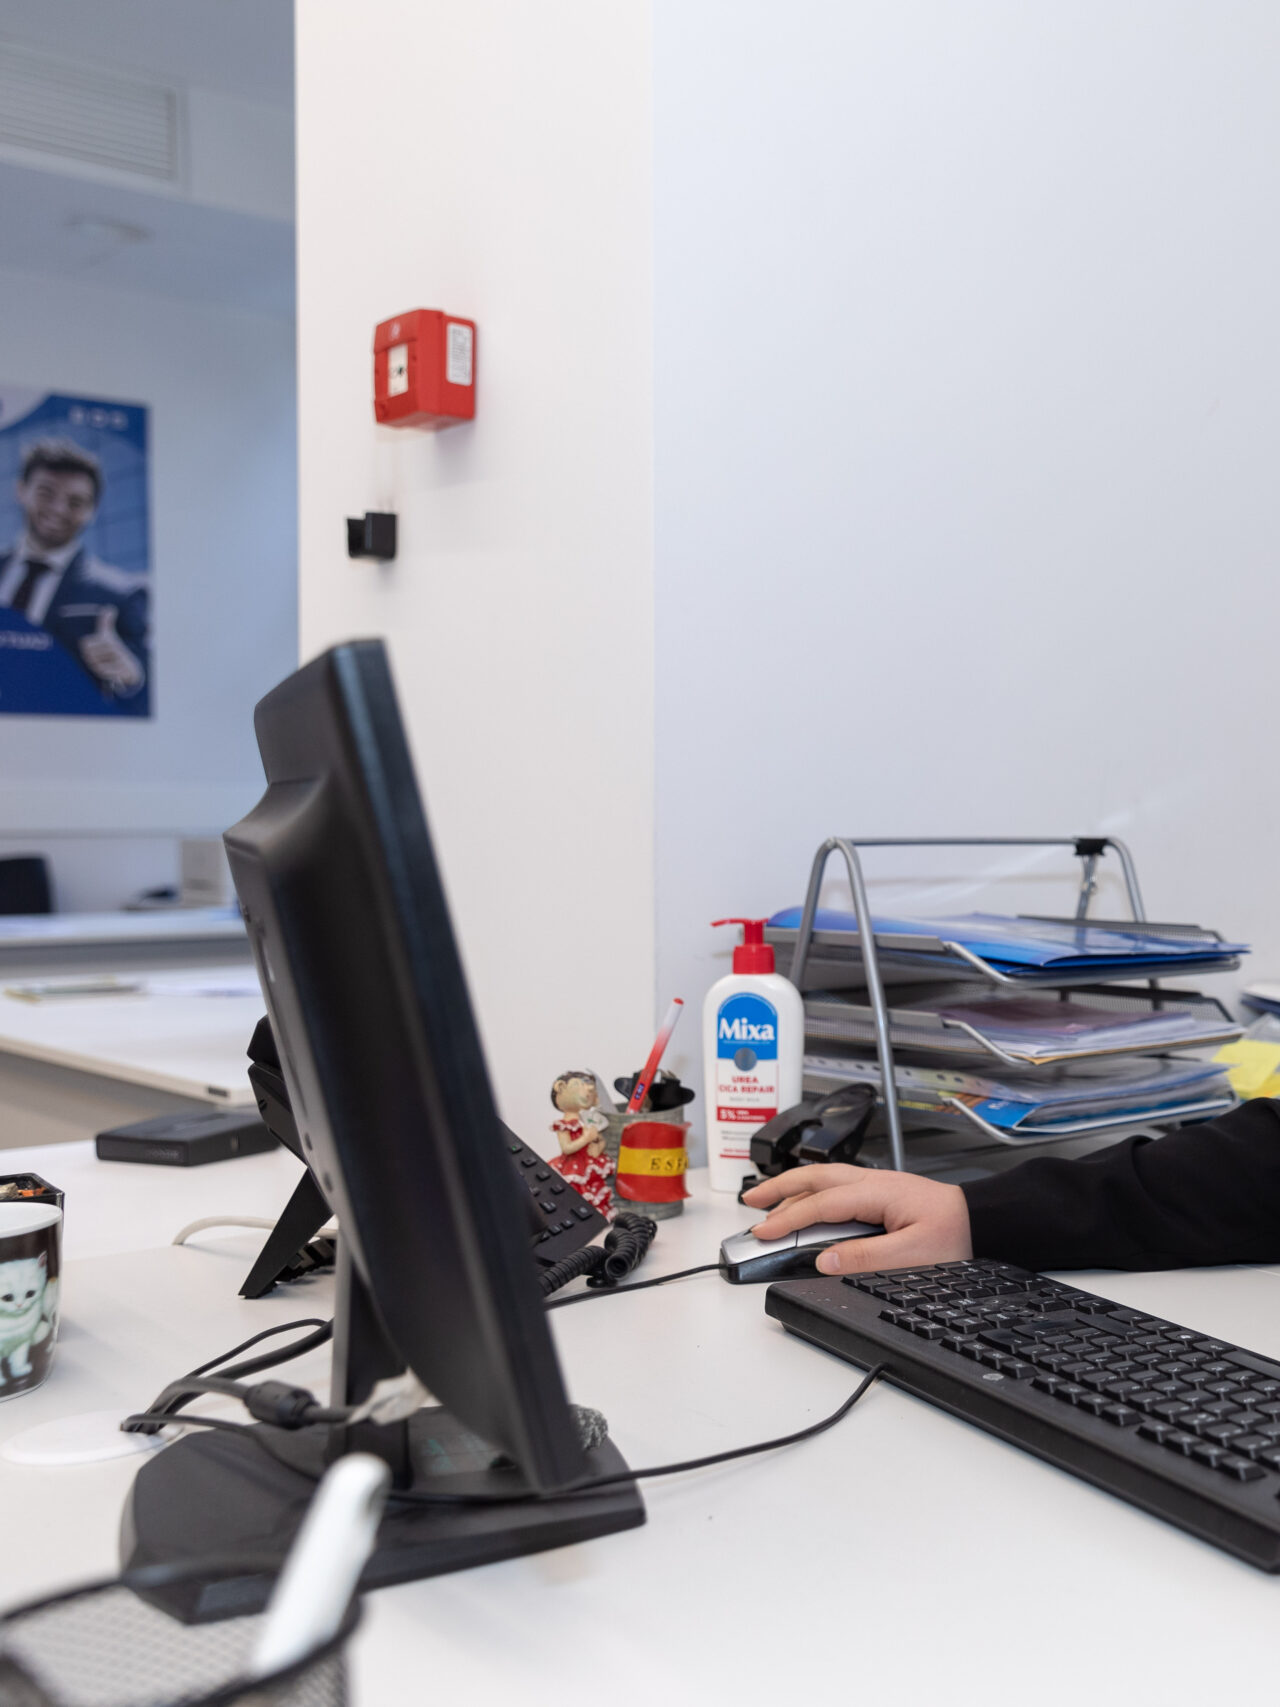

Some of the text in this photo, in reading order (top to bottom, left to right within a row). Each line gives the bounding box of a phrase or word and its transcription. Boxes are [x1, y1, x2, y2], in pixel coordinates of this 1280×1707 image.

[719, 1017, 775, 1041] Mixa
[731, 1075, 759, 1084] UREA
[741, 1085, 775, 1094] REPAIR
